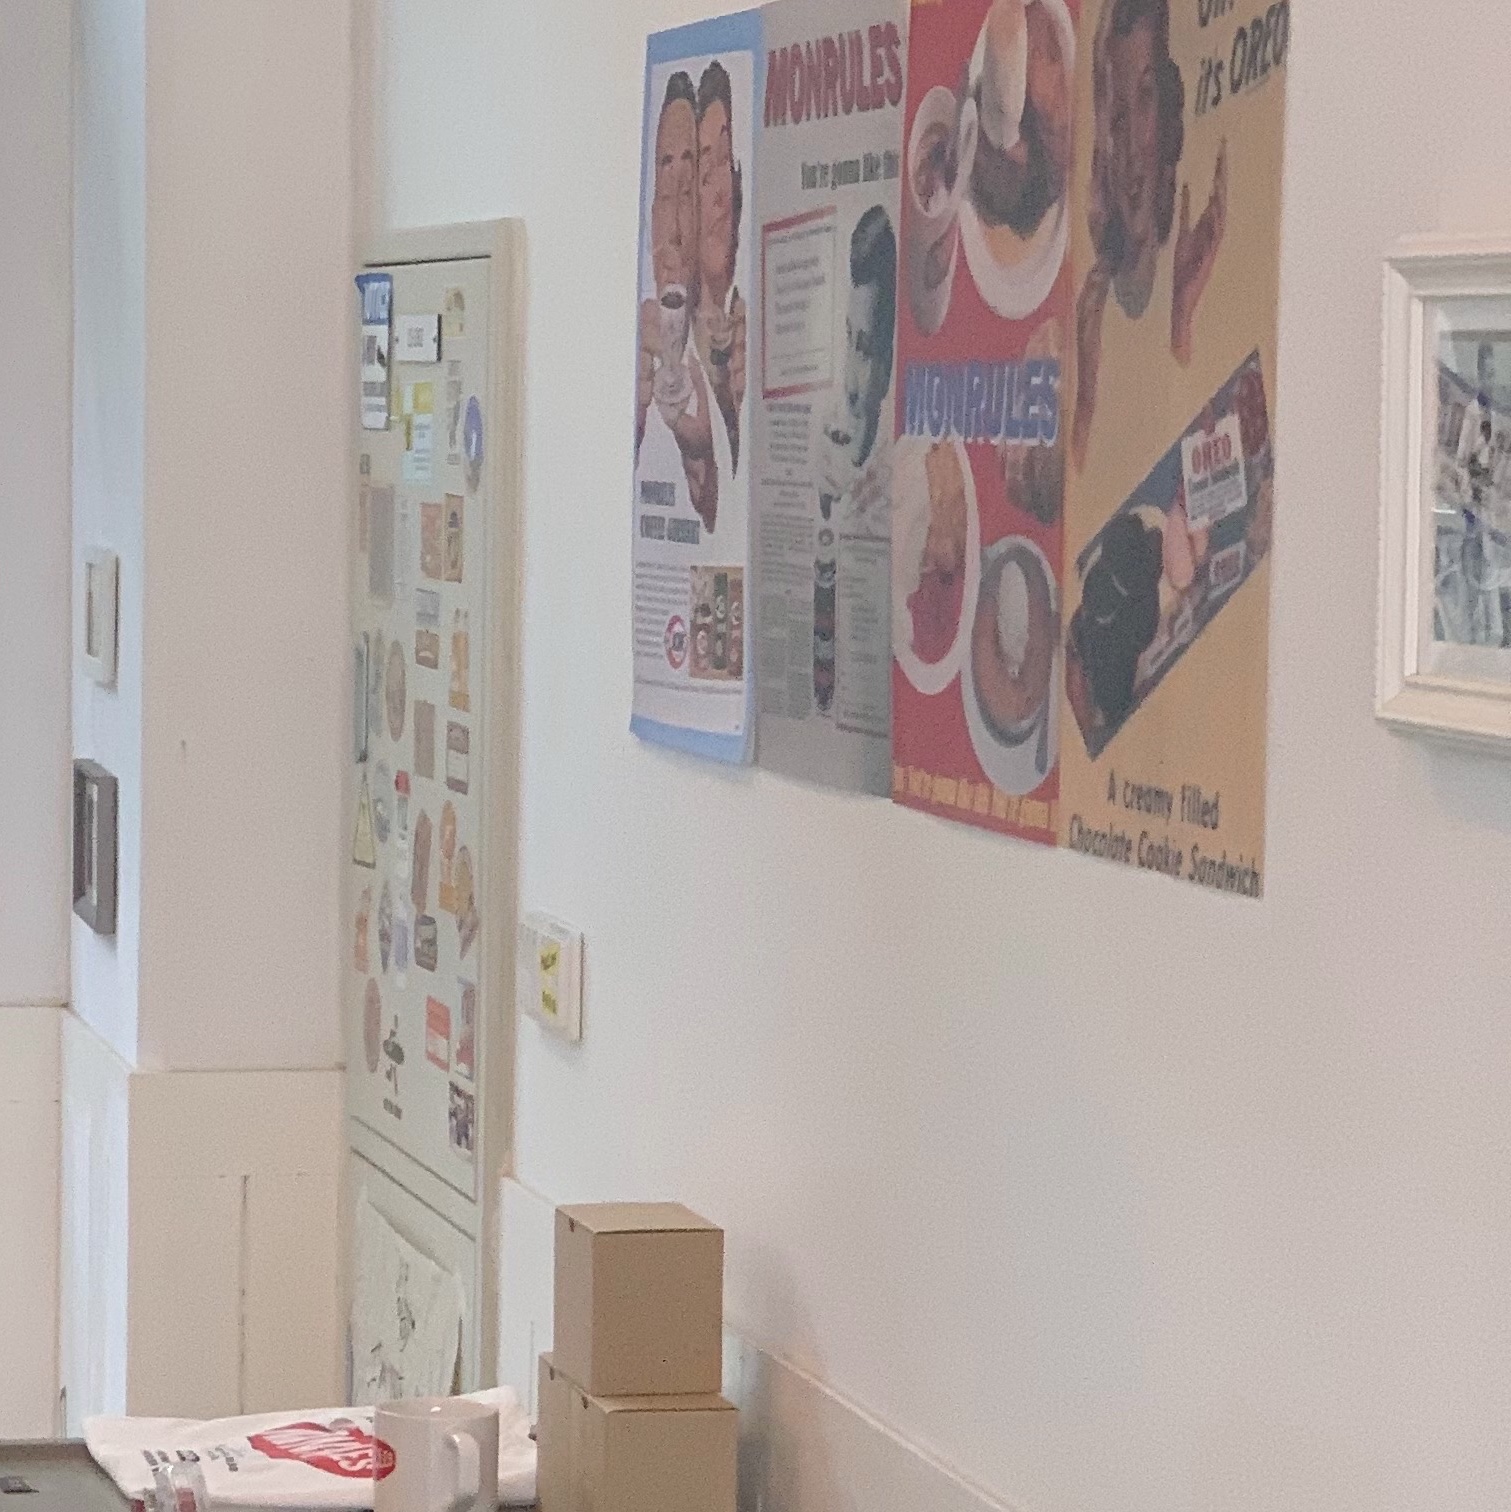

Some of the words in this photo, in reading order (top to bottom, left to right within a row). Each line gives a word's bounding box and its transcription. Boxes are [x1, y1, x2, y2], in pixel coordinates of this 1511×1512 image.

[764, 21, 903, 128] MONRULES
[905, 360, 1060, 447] MONRULES
[1107, 768, 1116, 804] A
[1123, 780, 1173, 825] creamy
[1069, 813, 1133, 863] Chocolate
[1137, 830, 1183, 876] Cookie
[1188, 842, 1260, 898] Sandwich
